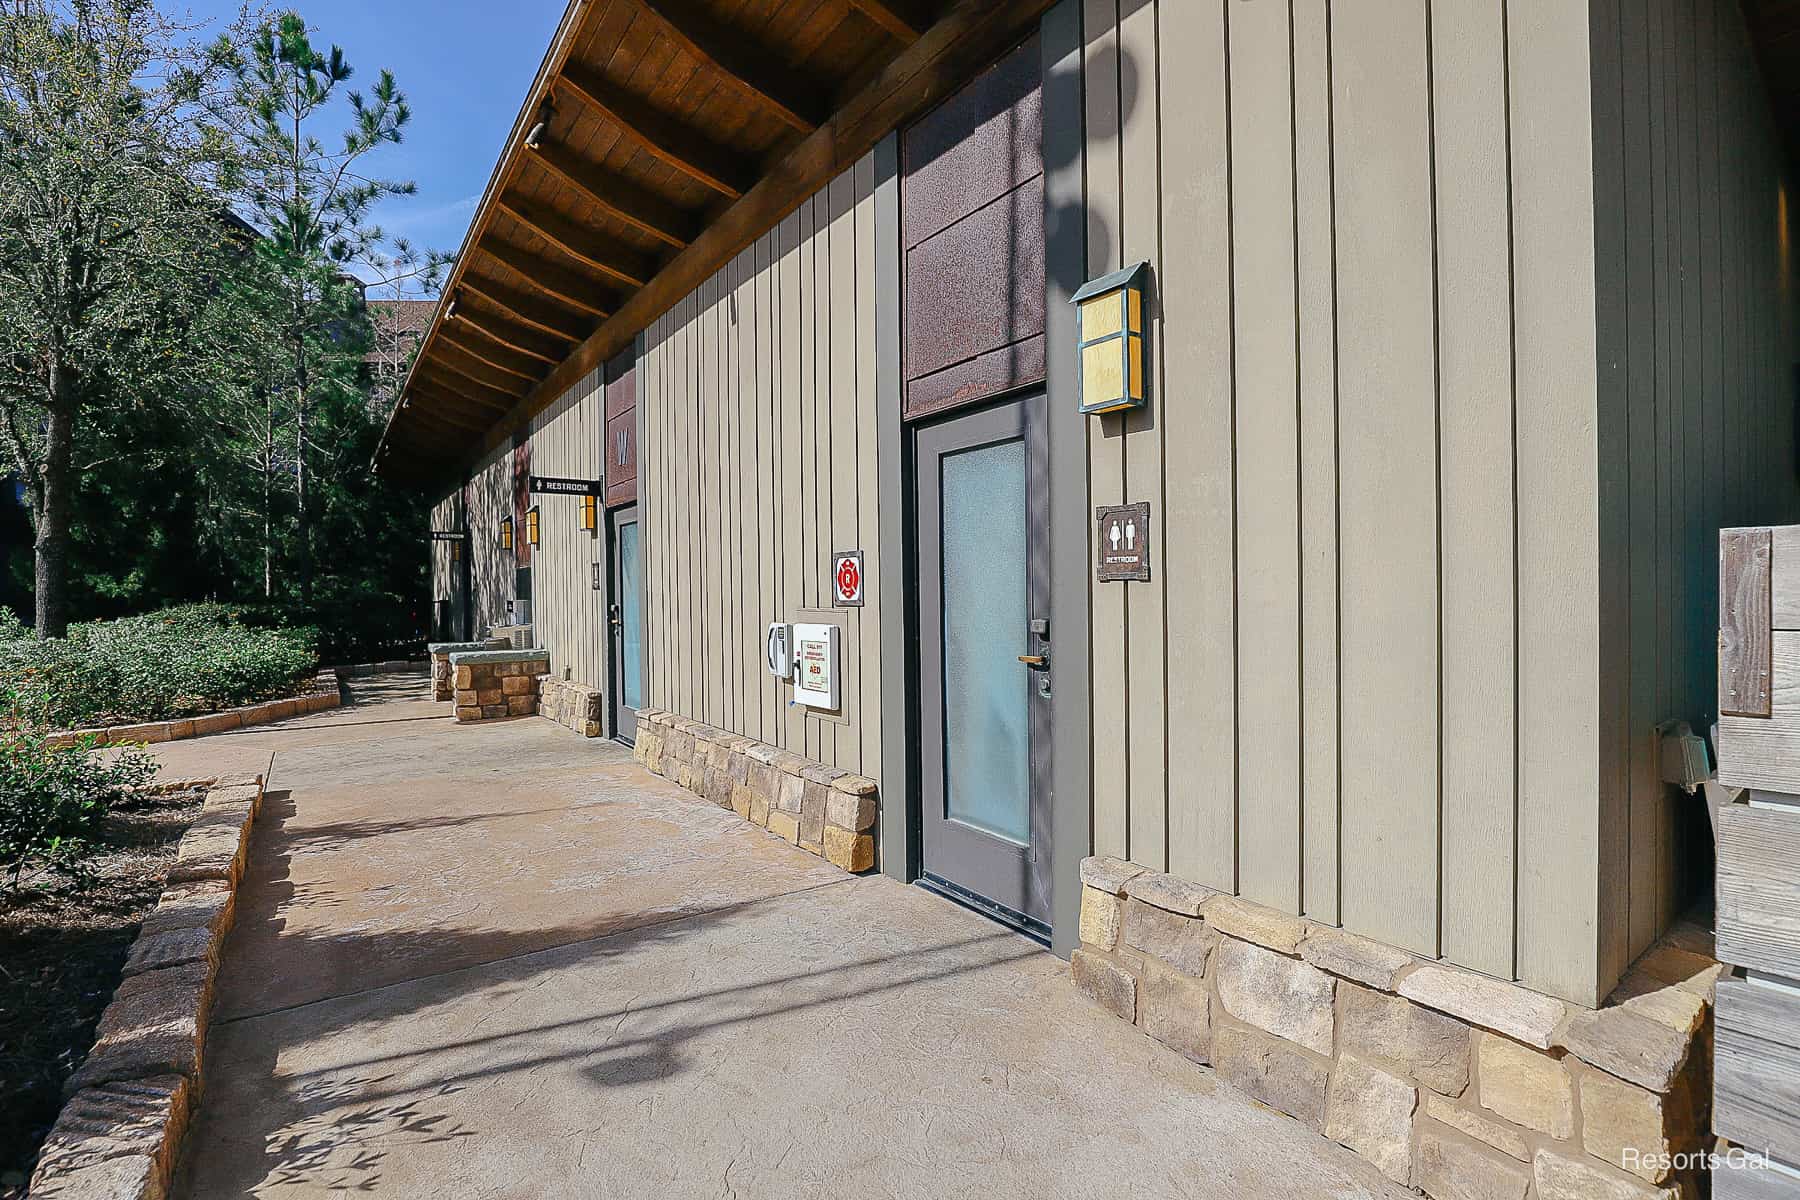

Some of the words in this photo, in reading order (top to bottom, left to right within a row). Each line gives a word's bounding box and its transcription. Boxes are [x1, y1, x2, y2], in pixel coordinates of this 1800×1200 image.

[616, 428, 629, 465] W
[546, 481, 589, 491] RESTROOM
[809, 665, 821, 675] AED
